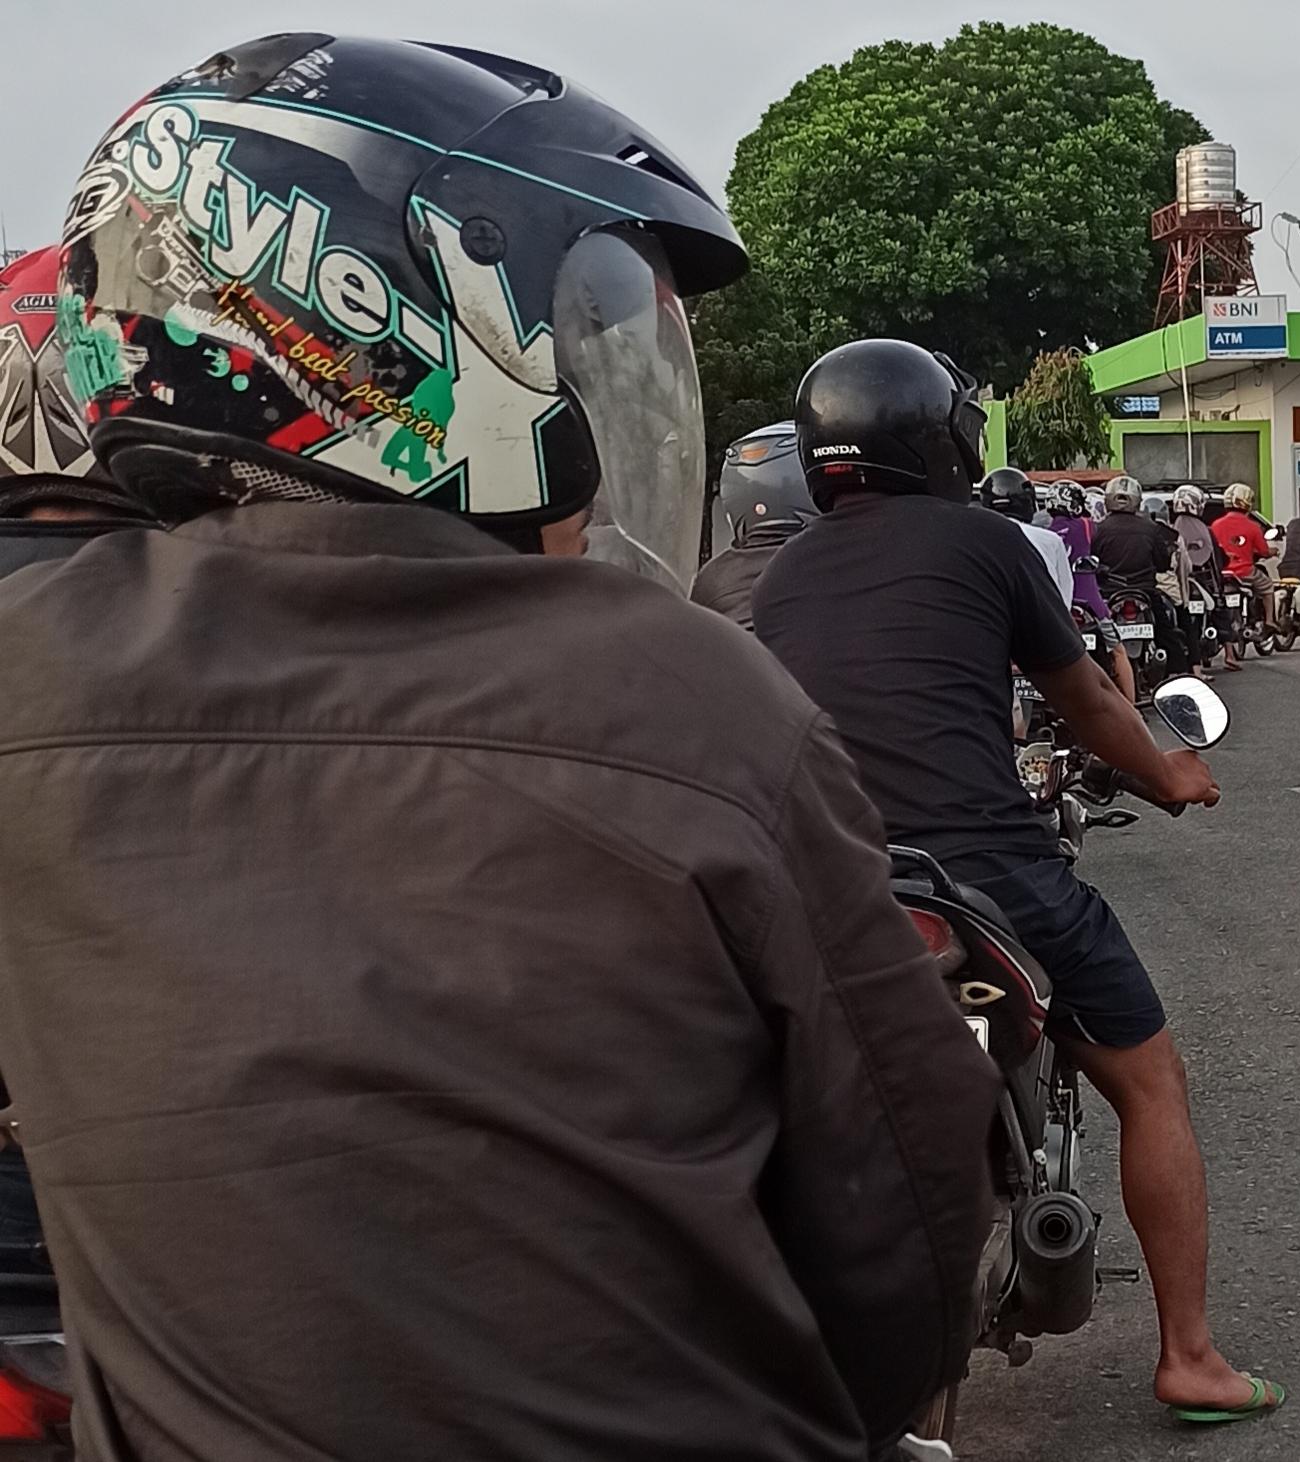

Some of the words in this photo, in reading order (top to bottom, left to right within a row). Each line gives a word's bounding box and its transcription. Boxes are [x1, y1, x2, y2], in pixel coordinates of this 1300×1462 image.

[19, 295, 58, 307] AGIV
[1229, 302, 1258, 317] BNI
[1214, 332, 1243, 345] ATM
[288, 332, 358, 382] beat
[340, 383, 447, 449] passion
[812, 444, 862, 458] HONDA
